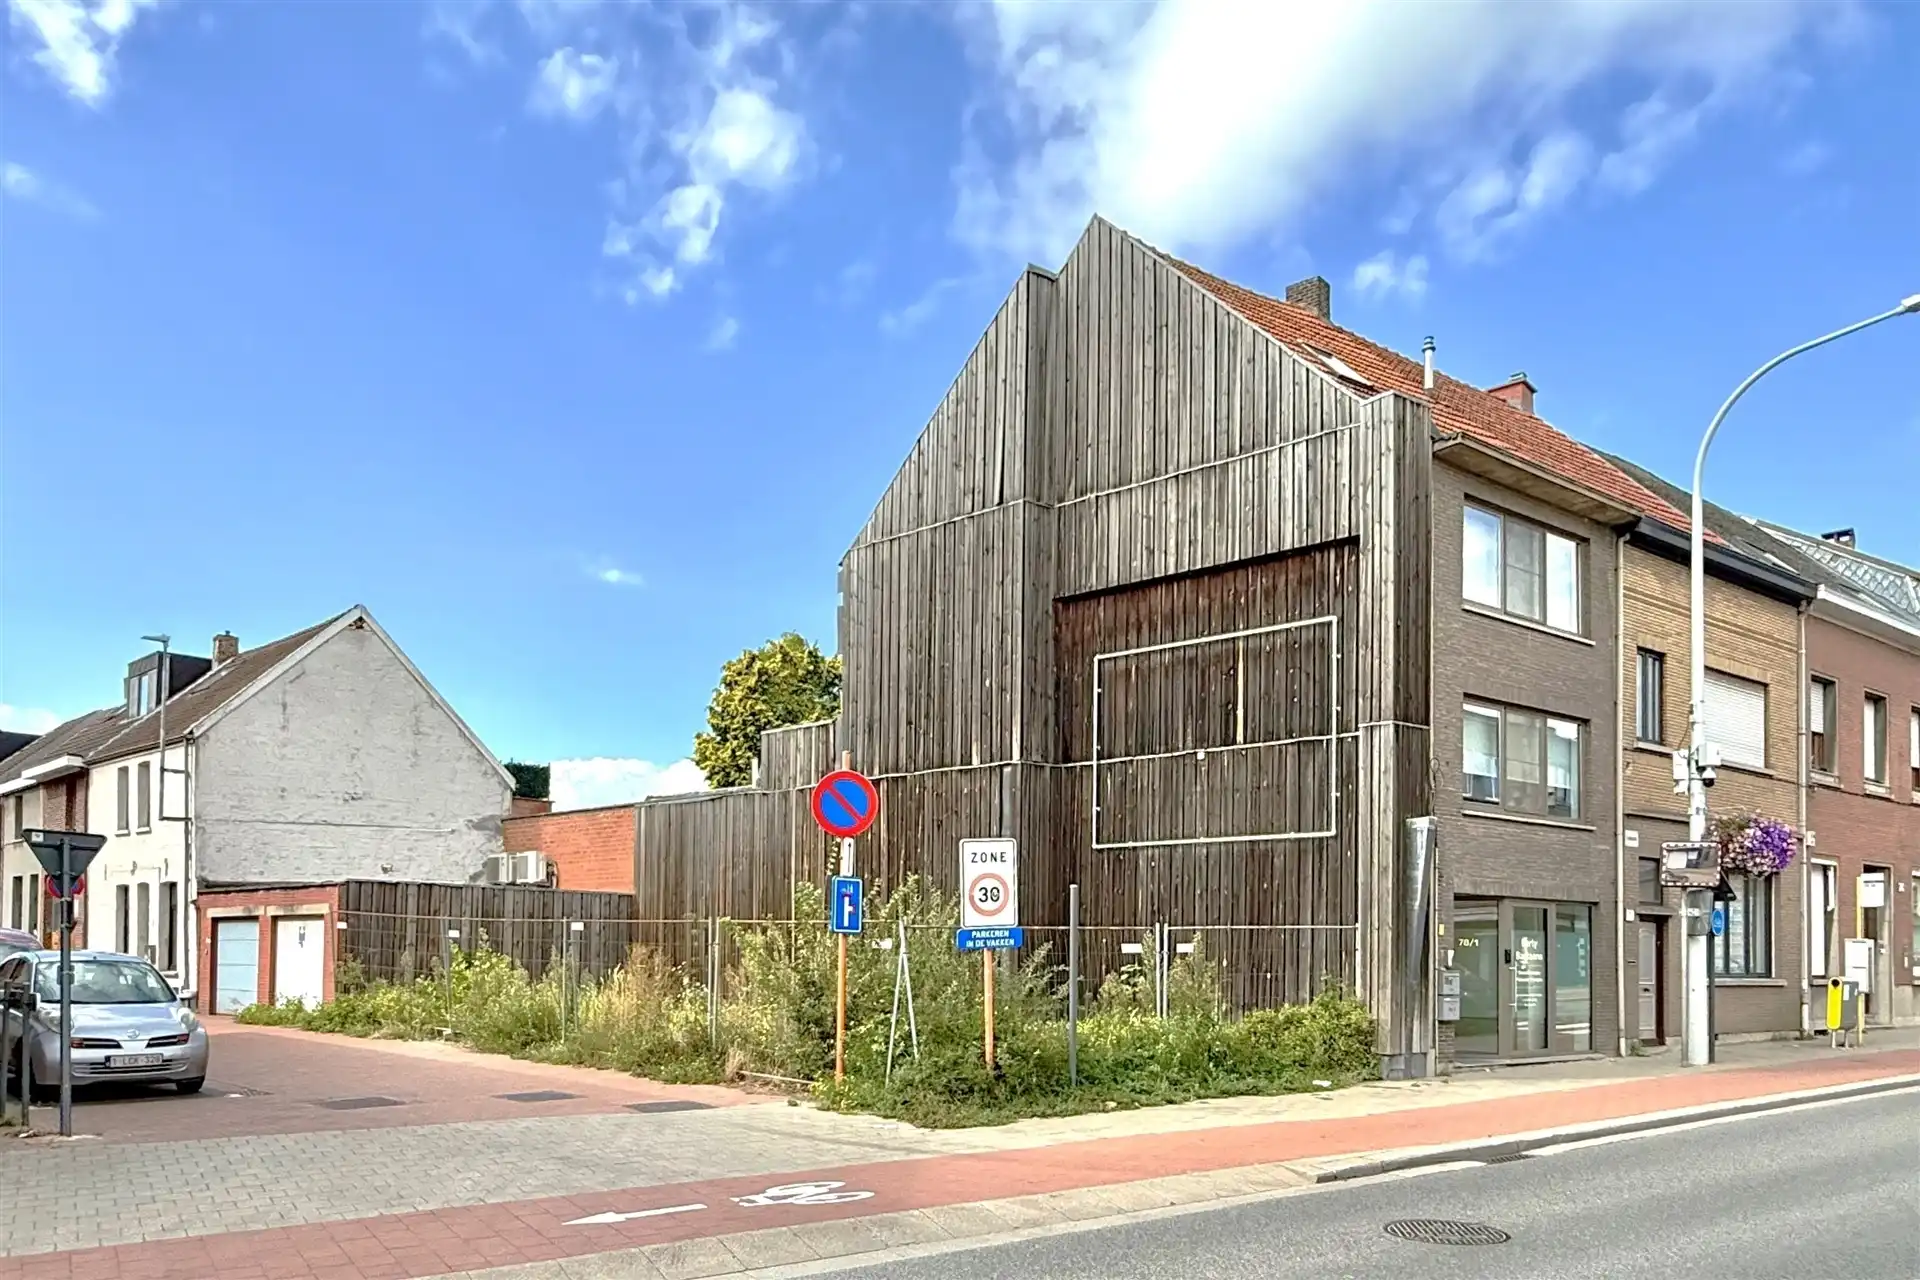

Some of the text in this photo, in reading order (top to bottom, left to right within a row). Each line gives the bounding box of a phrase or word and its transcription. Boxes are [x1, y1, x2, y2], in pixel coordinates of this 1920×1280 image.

[971, 852, 1007, 863] ZONE
[978, 887, 1000, 903] 30
[971, 930, 1009, 938] PARKEREN
[975, 939, 985, 947] DE
[986, 938, 1014, 947] VAKKEN
